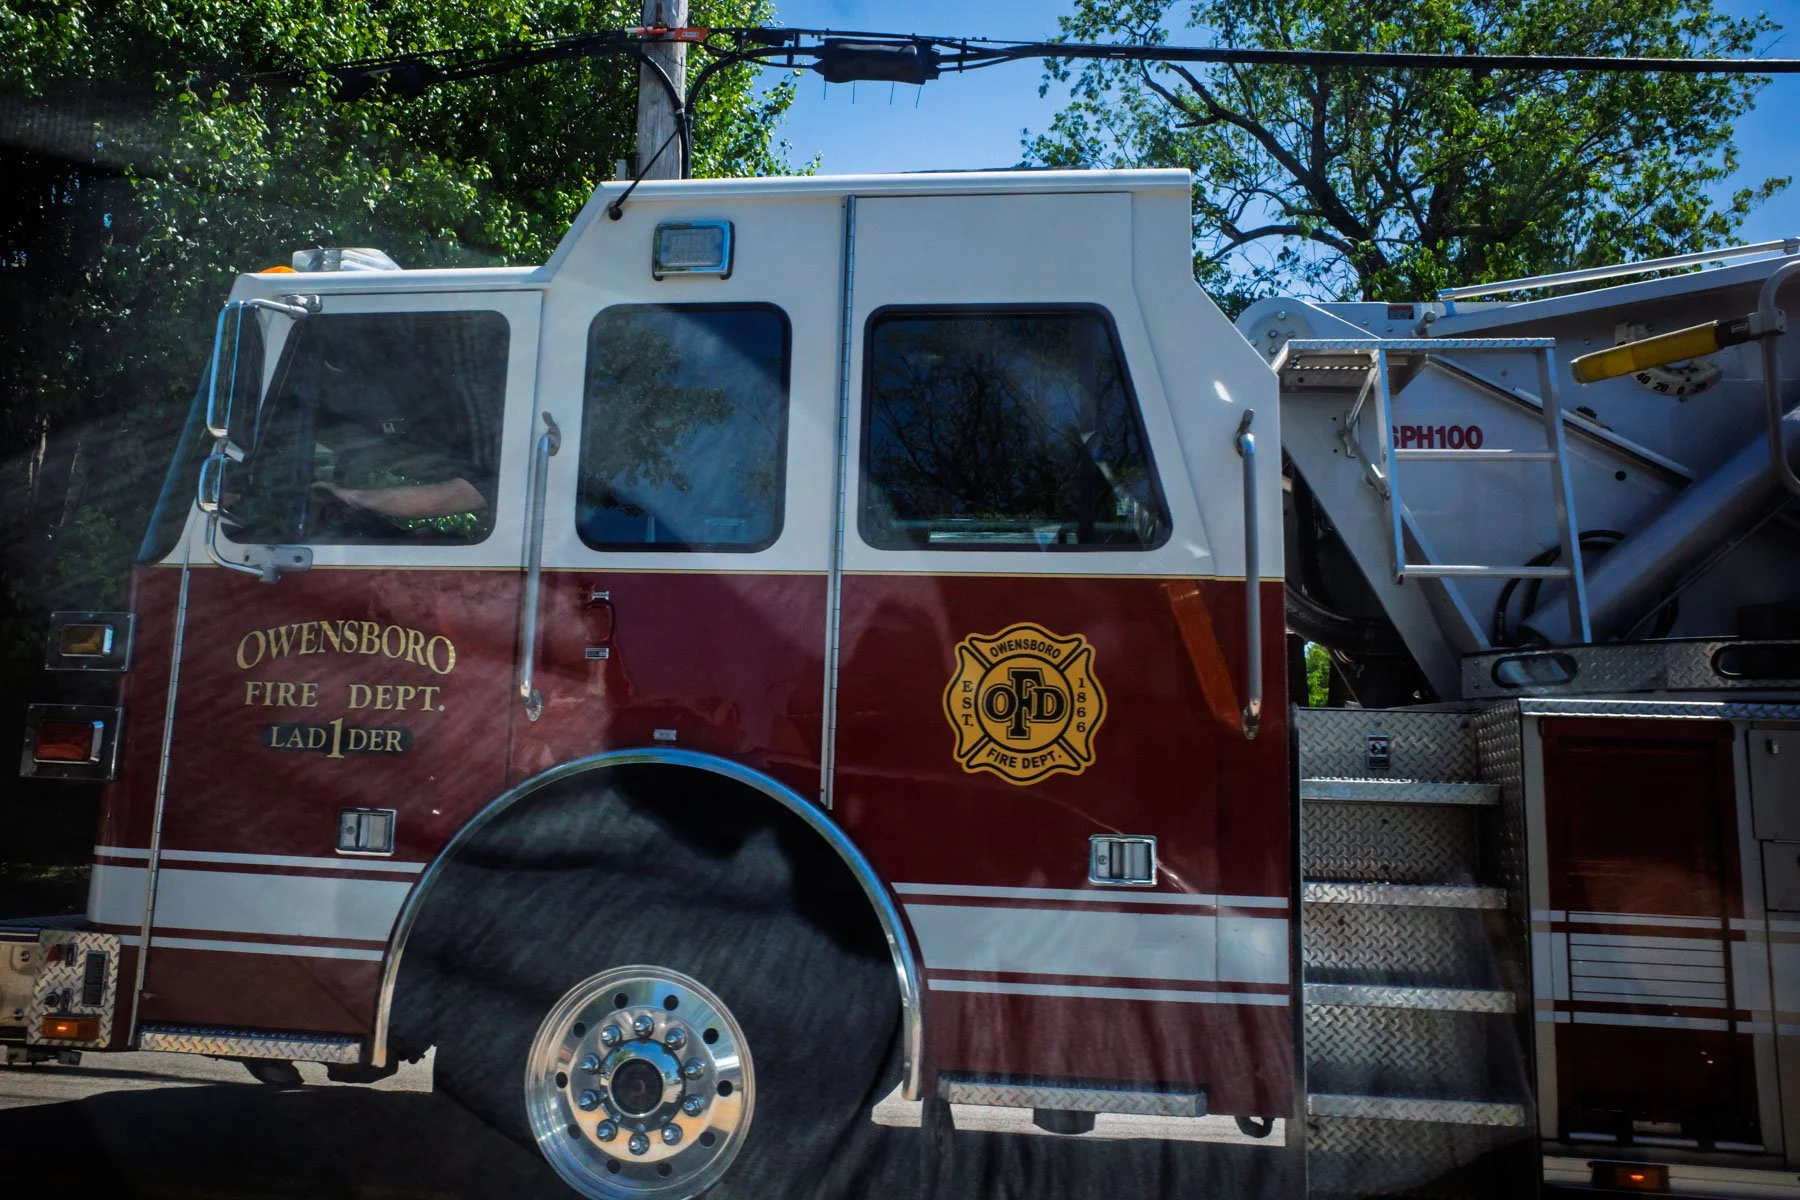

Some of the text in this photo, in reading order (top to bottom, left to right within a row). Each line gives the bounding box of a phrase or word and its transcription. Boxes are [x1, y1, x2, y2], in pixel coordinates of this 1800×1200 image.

[1652, 382, 1670, 393] 20
[1677, 386, 1686, 395] 0
[236, 620, 456, 675] OWENSBORO
[989, 638, 1062, 659] OWENSBORO
[244, 681, 446, 712] FIRE DEPT.
[961, 680, 975, 727] EST.
[1076, 677, 1087, 733] 1866
[986, 747, 1063, 770] FIRE DEPT.
